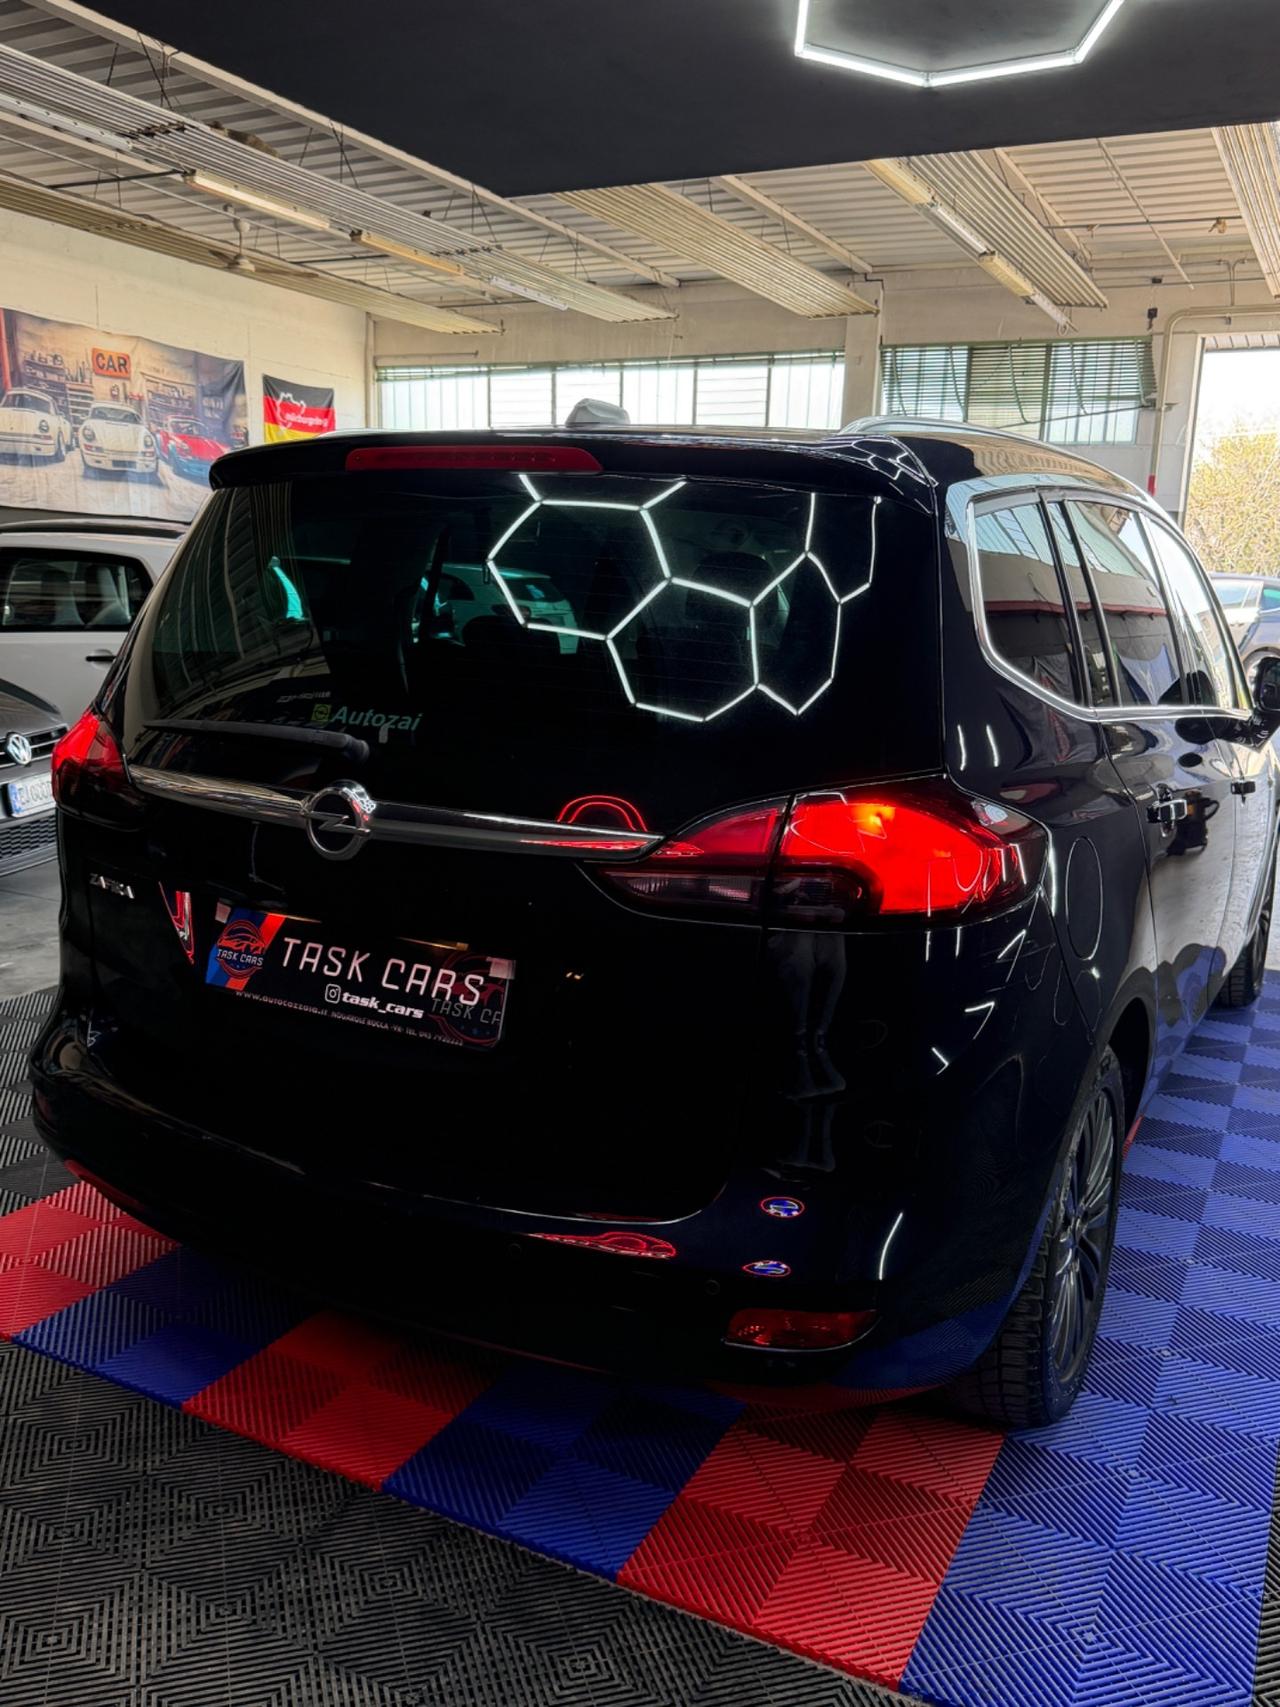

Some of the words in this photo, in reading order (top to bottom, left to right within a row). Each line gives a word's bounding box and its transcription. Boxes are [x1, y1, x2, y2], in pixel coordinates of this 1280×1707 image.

[96, 352, 129, 374] CAR
[217, 948, 239, 961] TASK
[239, 953, 265, 967] CARS
[283, 937, 371, 983] TASK
[381, 957, 485, 1006] CARS
[342, 991, 425, 1019] task_cars
[431, 998, 475, 1021] TASK
